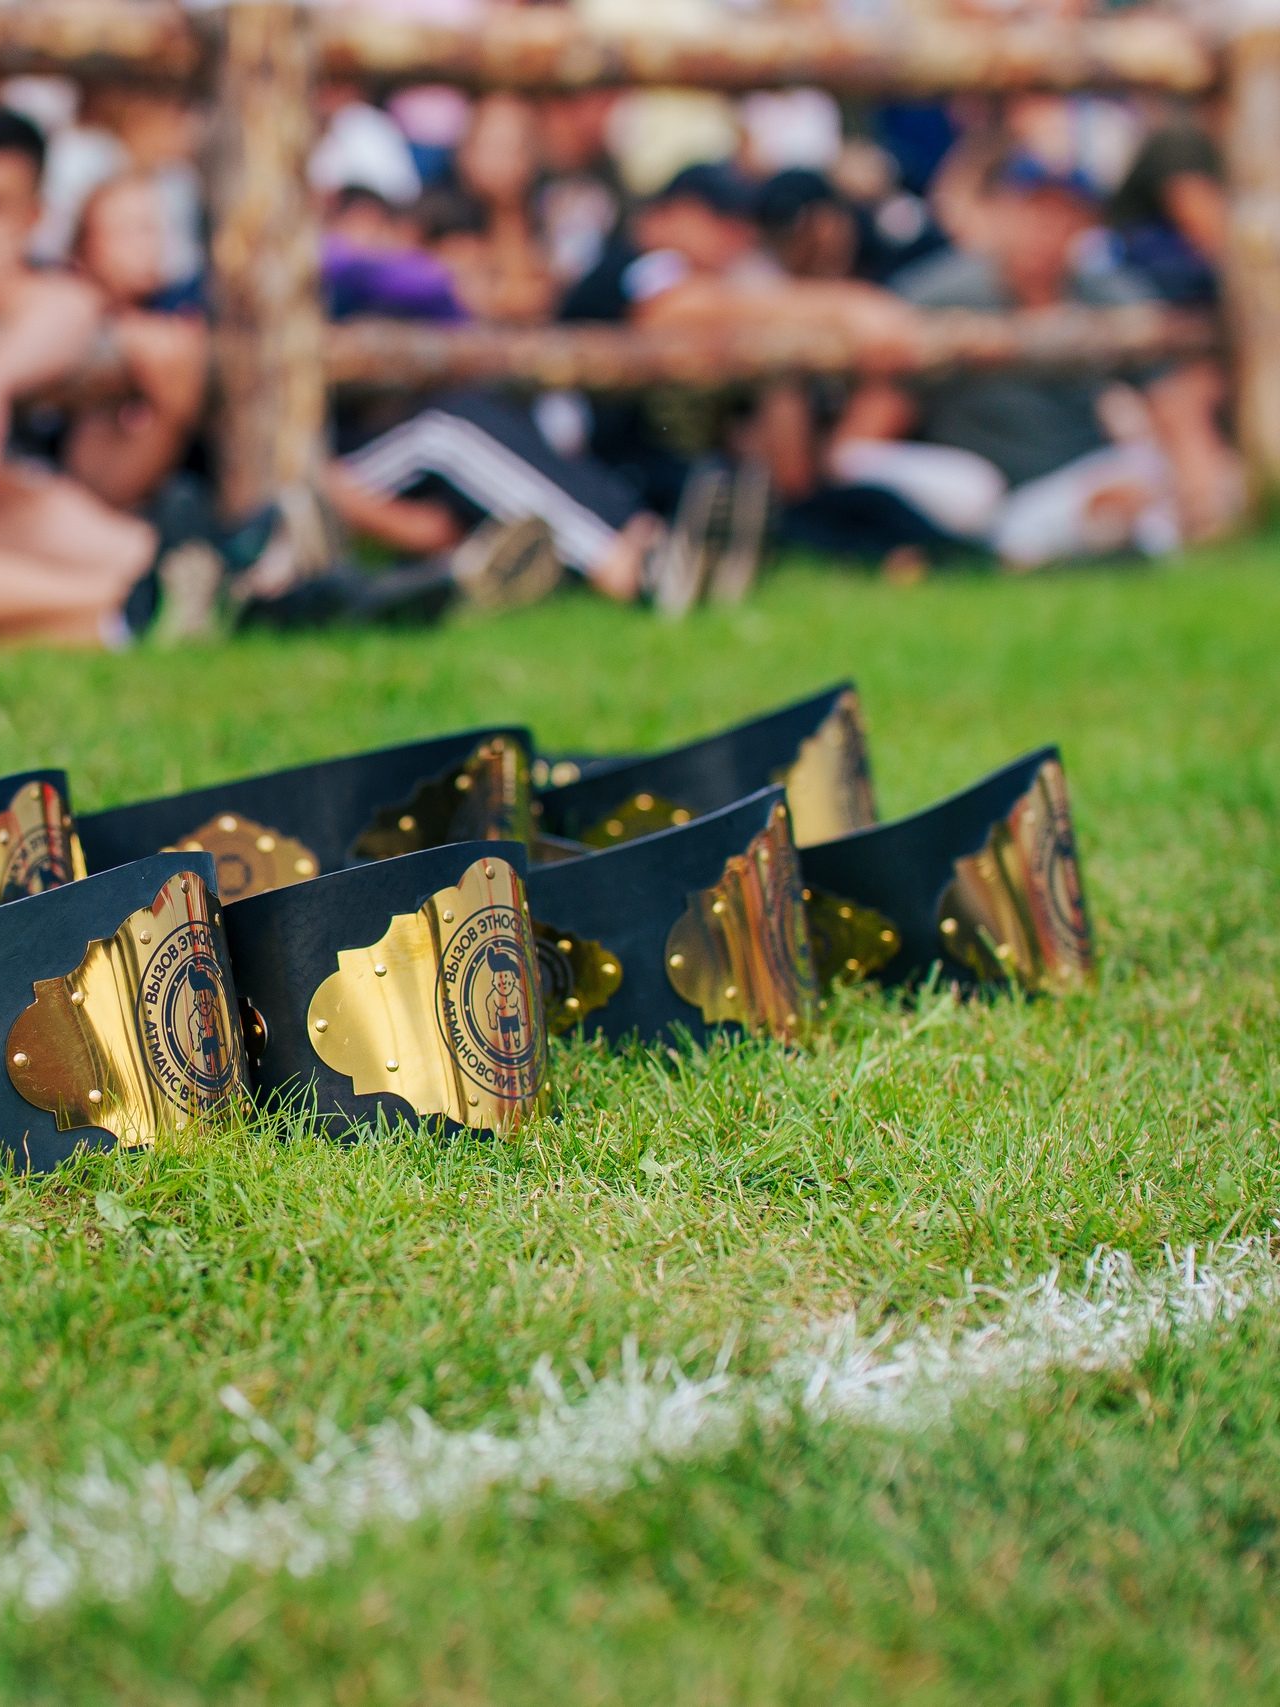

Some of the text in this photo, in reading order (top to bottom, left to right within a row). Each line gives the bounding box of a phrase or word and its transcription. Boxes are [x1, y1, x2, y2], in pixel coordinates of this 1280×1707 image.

[145, 942, 180, 1006] ВЫЗОВ
[443, 927, 479, 985] ВЫЗОВ
[442, 997, 517, 1091] АТМАНОВСКИЕ
